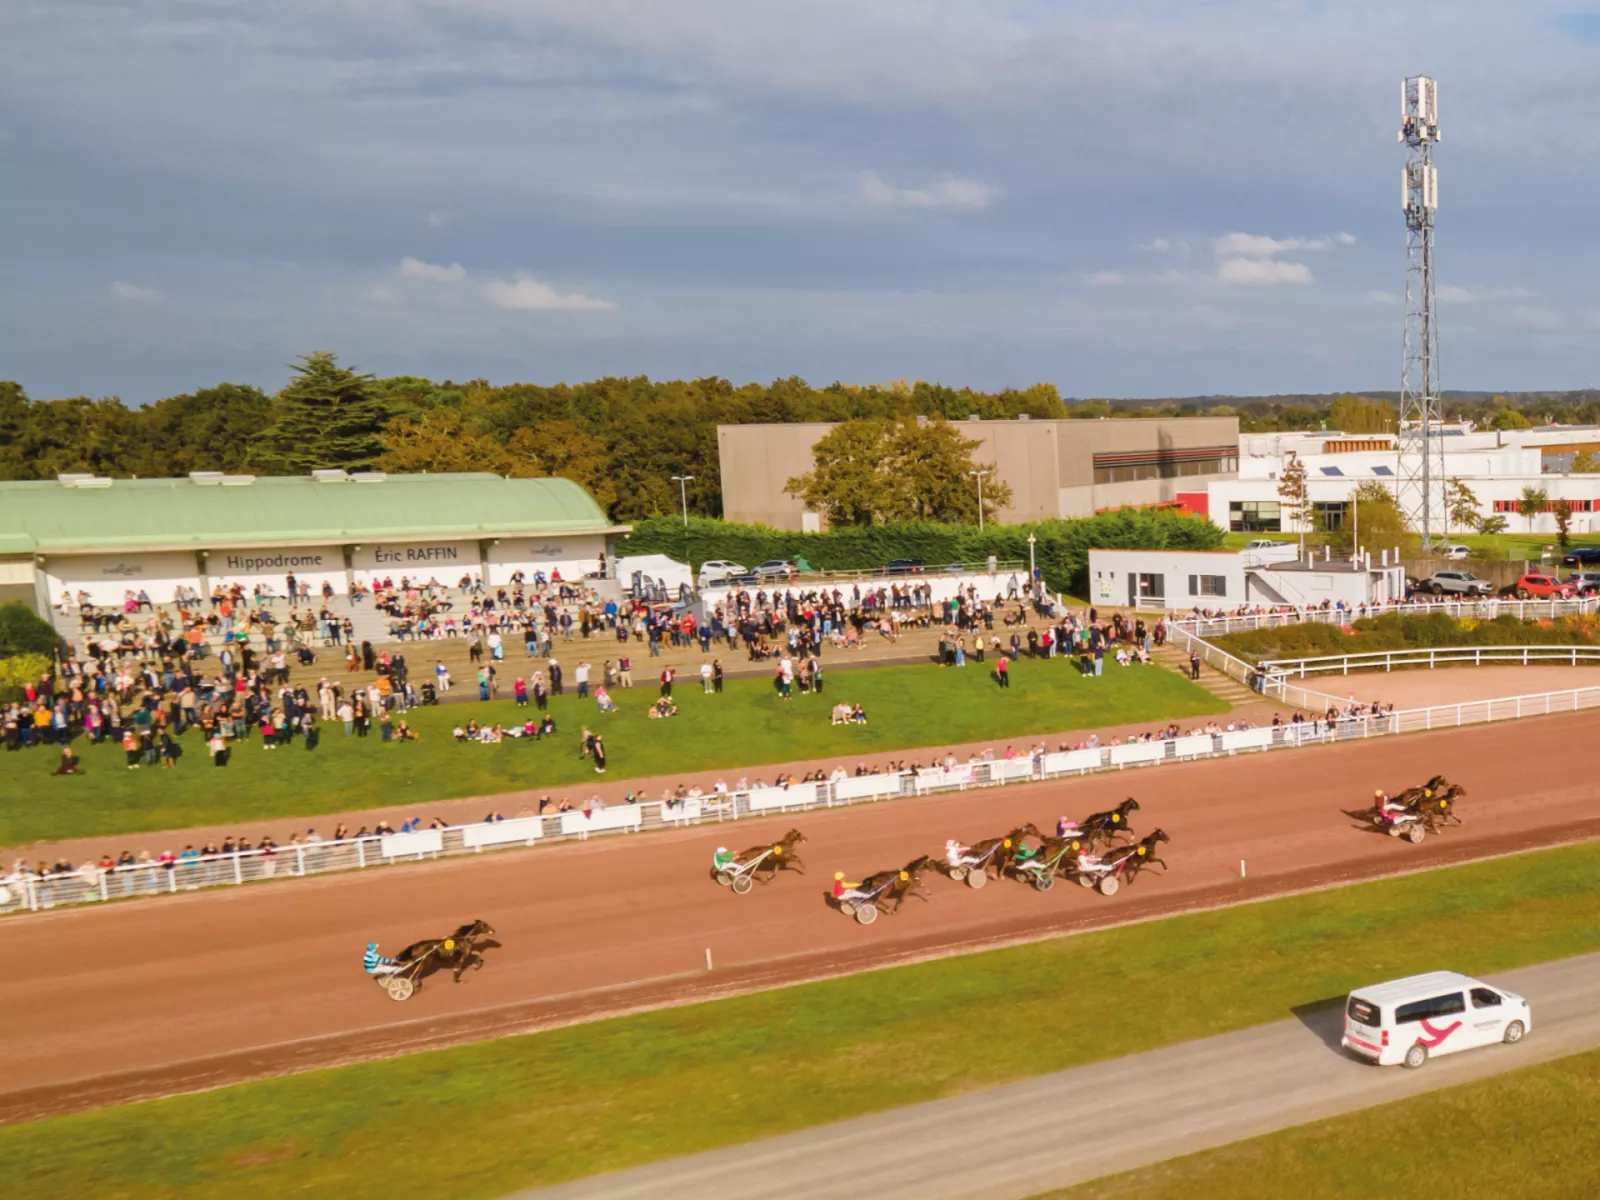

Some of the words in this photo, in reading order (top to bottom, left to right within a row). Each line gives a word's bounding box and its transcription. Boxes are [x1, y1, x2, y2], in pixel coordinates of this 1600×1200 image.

[227, 554, 322, 571] Hippodrome
[375, 545, 402, 563] Éric
[407, 547, 457, 561] RAFFIN
